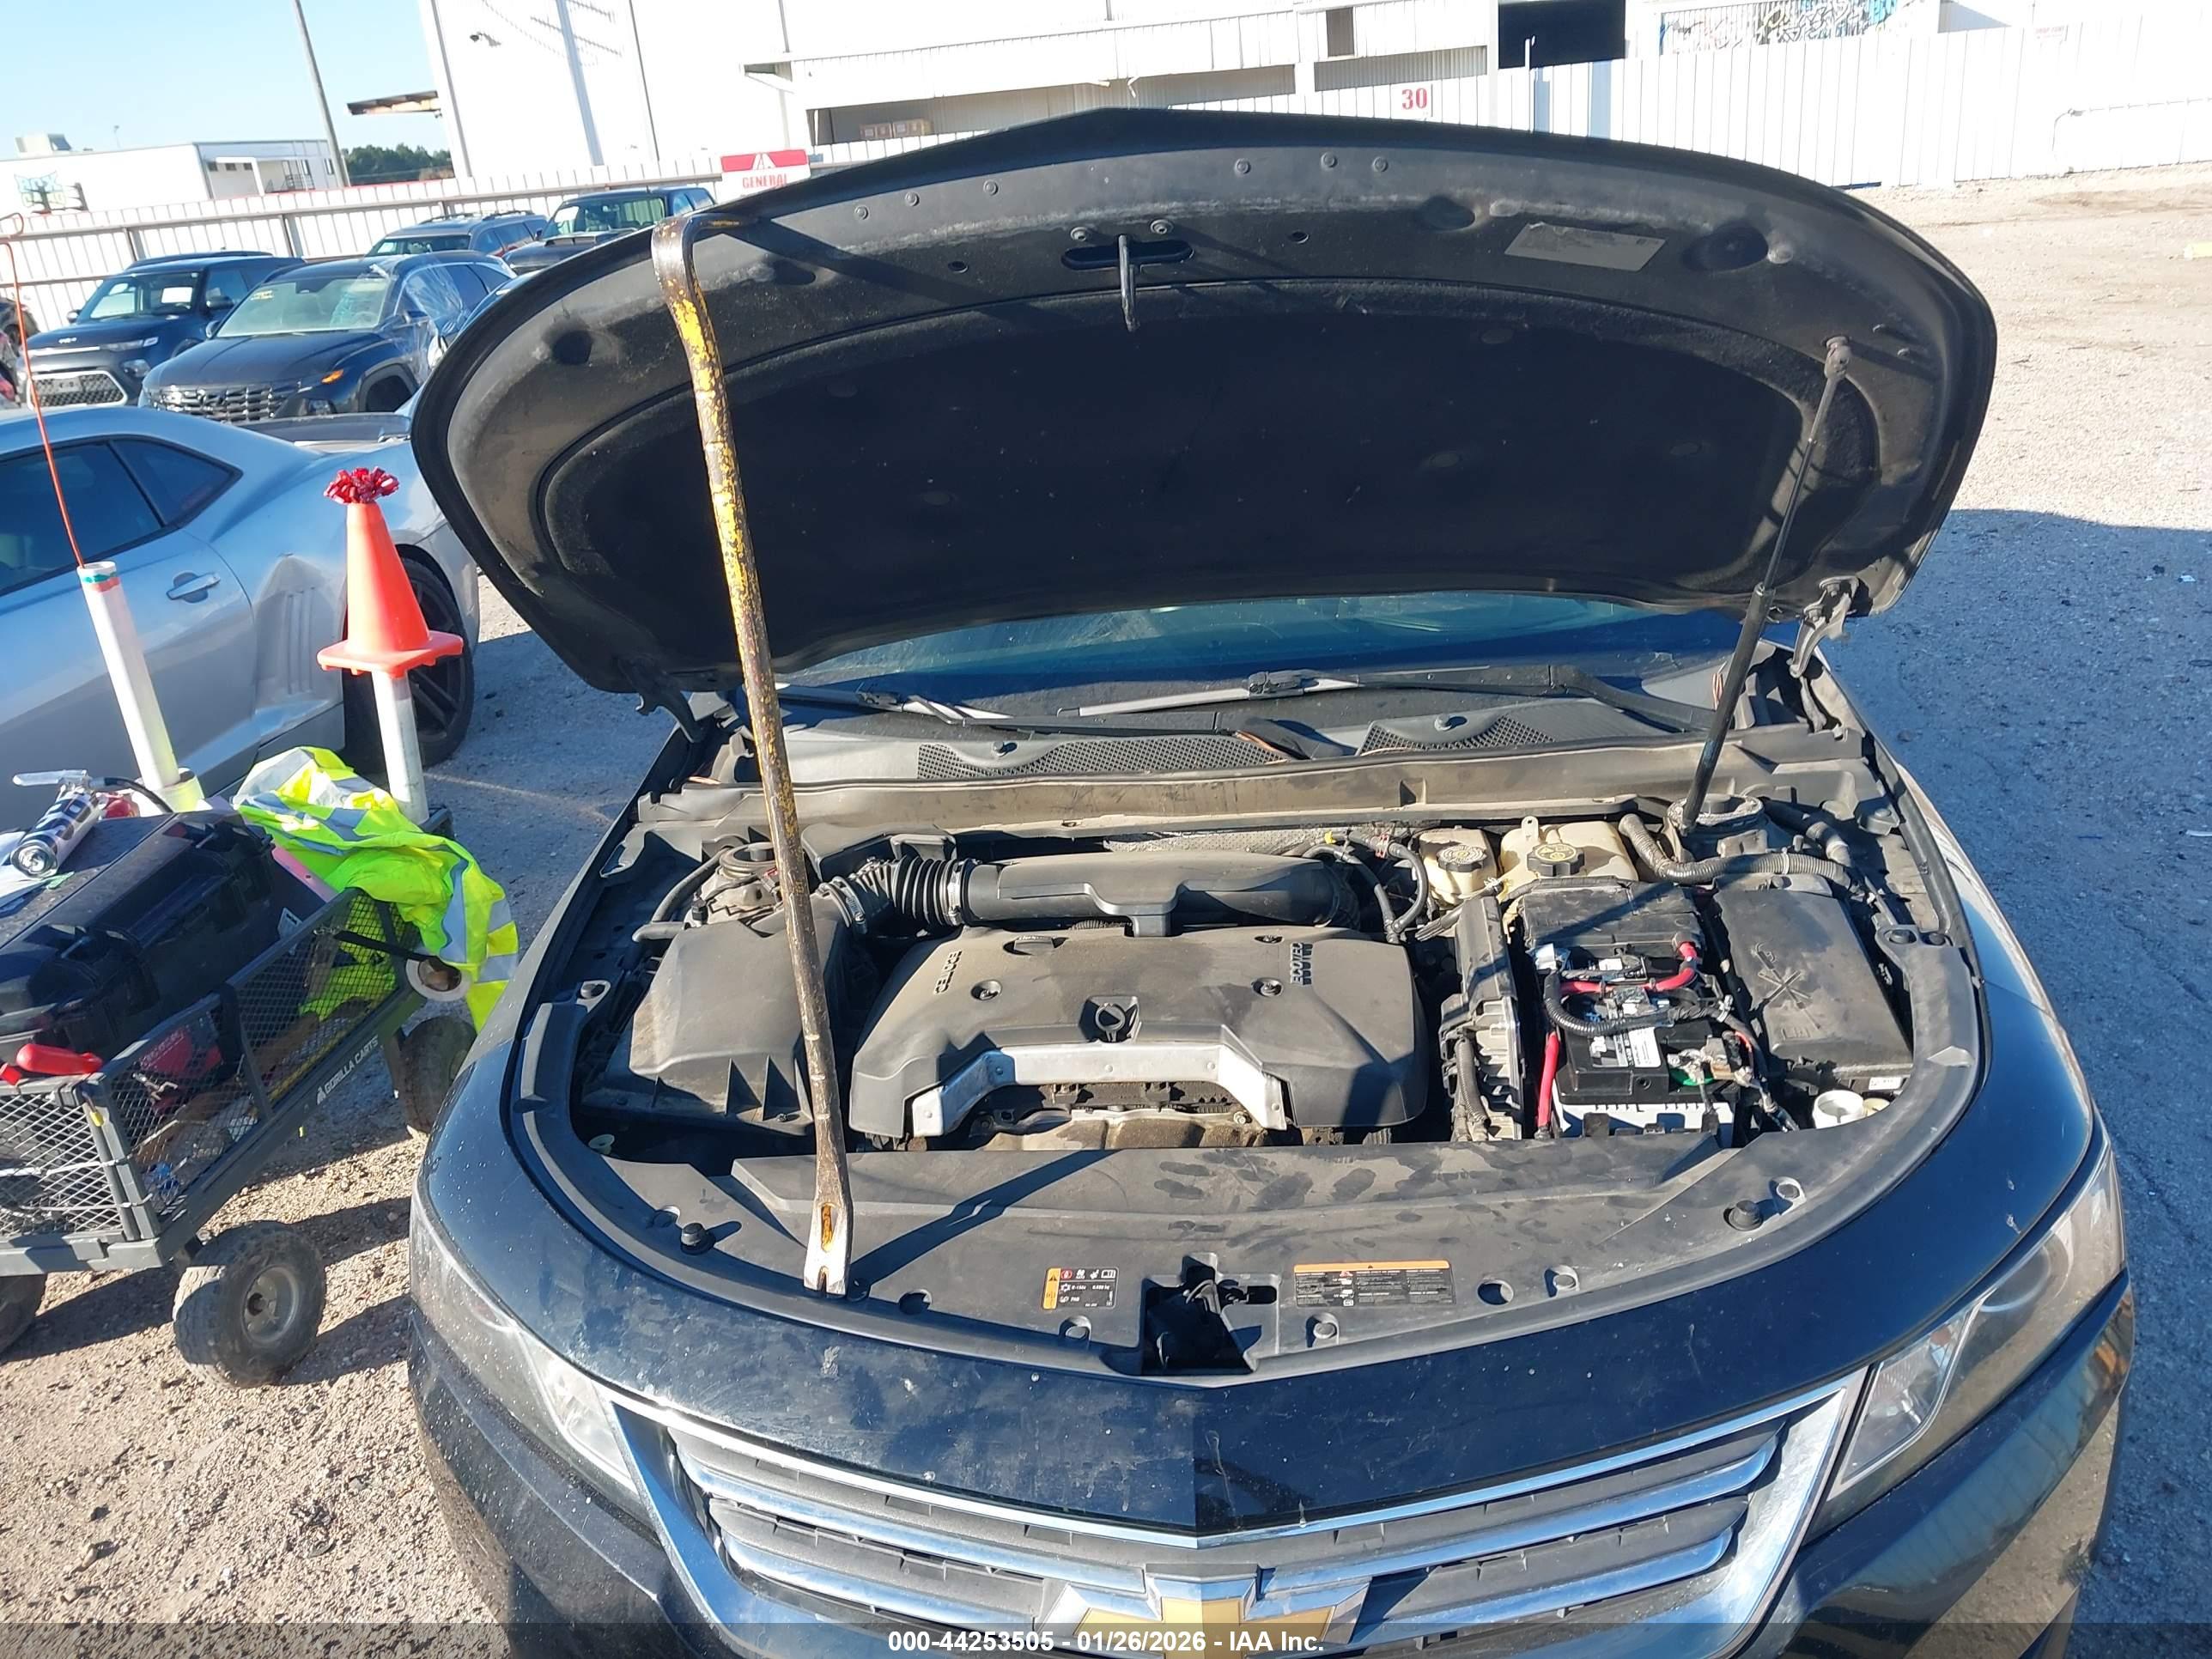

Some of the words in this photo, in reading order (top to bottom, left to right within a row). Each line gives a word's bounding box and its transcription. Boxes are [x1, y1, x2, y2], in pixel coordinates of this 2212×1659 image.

[1401, 88, 1428, 110] 30
[1290, 942, 1313, 986] ECOTEC
[324, 1059, 355, 1094] GORILLA
[354, 1034, 379, 1065] CARTS
